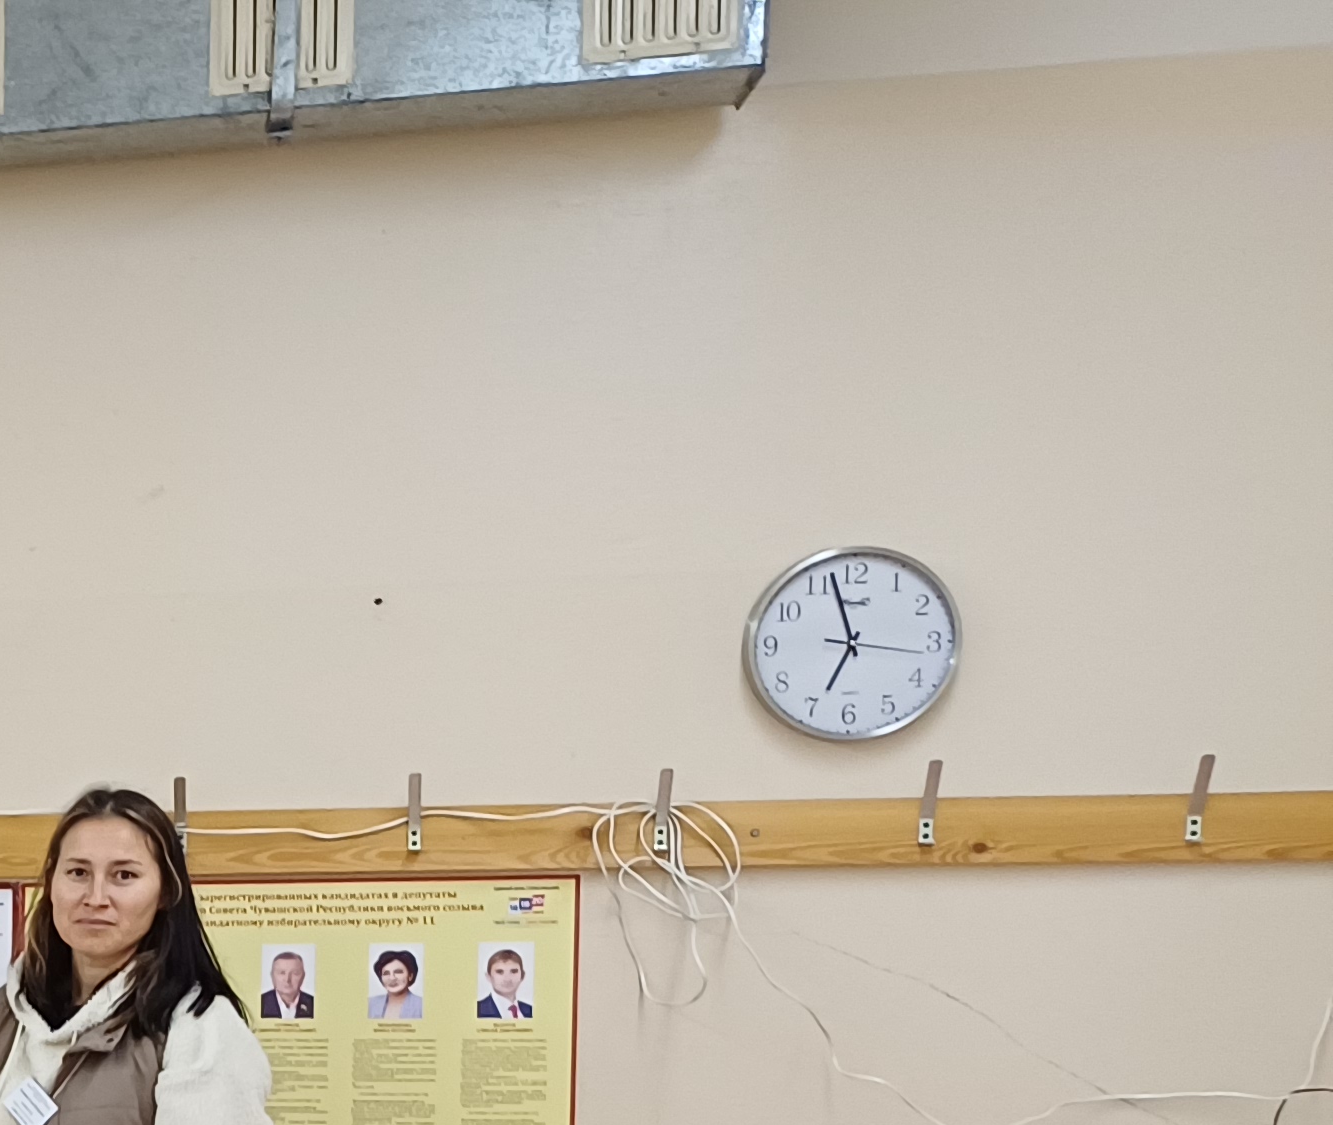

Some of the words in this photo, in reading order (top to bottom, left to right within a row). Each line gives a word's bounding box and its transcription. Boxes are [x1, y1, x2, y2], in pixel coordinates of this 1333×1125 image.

[842, 562, 869, 584] 12
[891, 572, 901, 592] 1
[805, 574, 830, 595] 11
[777, 600, 801, 622] 10
[915, 594, 930, 616] 2
[763, 635, 778, 657] 9
[926, 630, 942, 653] 3
[774, 671, 789, 693] 8
[908, 667, 924, 688] 4
[804, 696, 819, 717] 7
[841, 703, 856, 725] 6
[880, 694, 895, 715] 5
